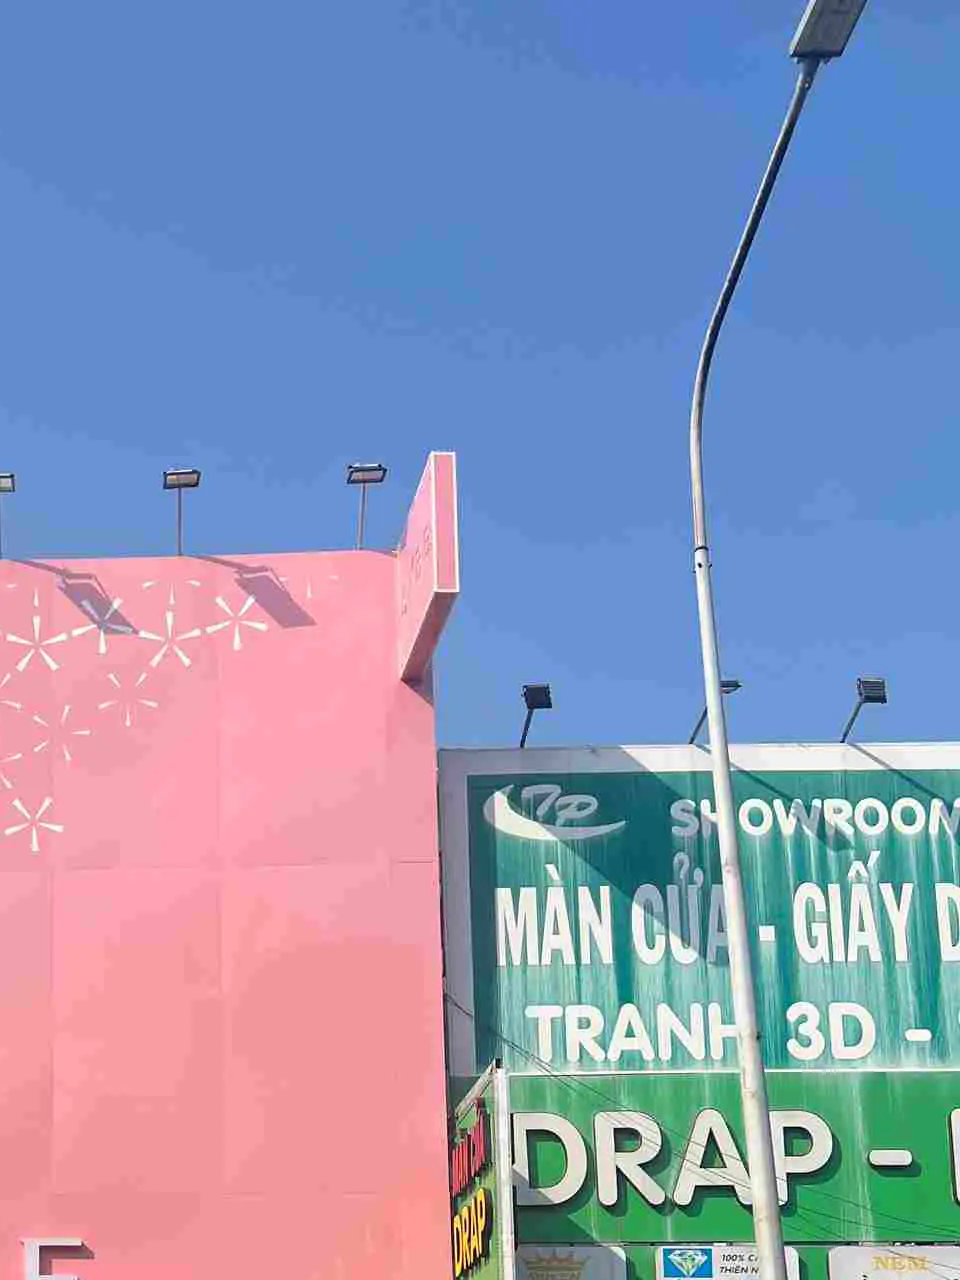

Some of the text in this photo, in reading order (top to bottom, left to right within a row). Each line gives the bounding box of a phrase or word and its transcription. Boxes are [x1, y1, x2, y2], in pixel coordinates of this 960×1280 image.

[496, 863, 614, 966] MÀN
[792, 850, 913, 964] GIẤY
[786, 1001, 876, 1061] 3D
[512, 1107, 834, 1207] DRAP
[453, 1187, 487, 1278] DRAP
